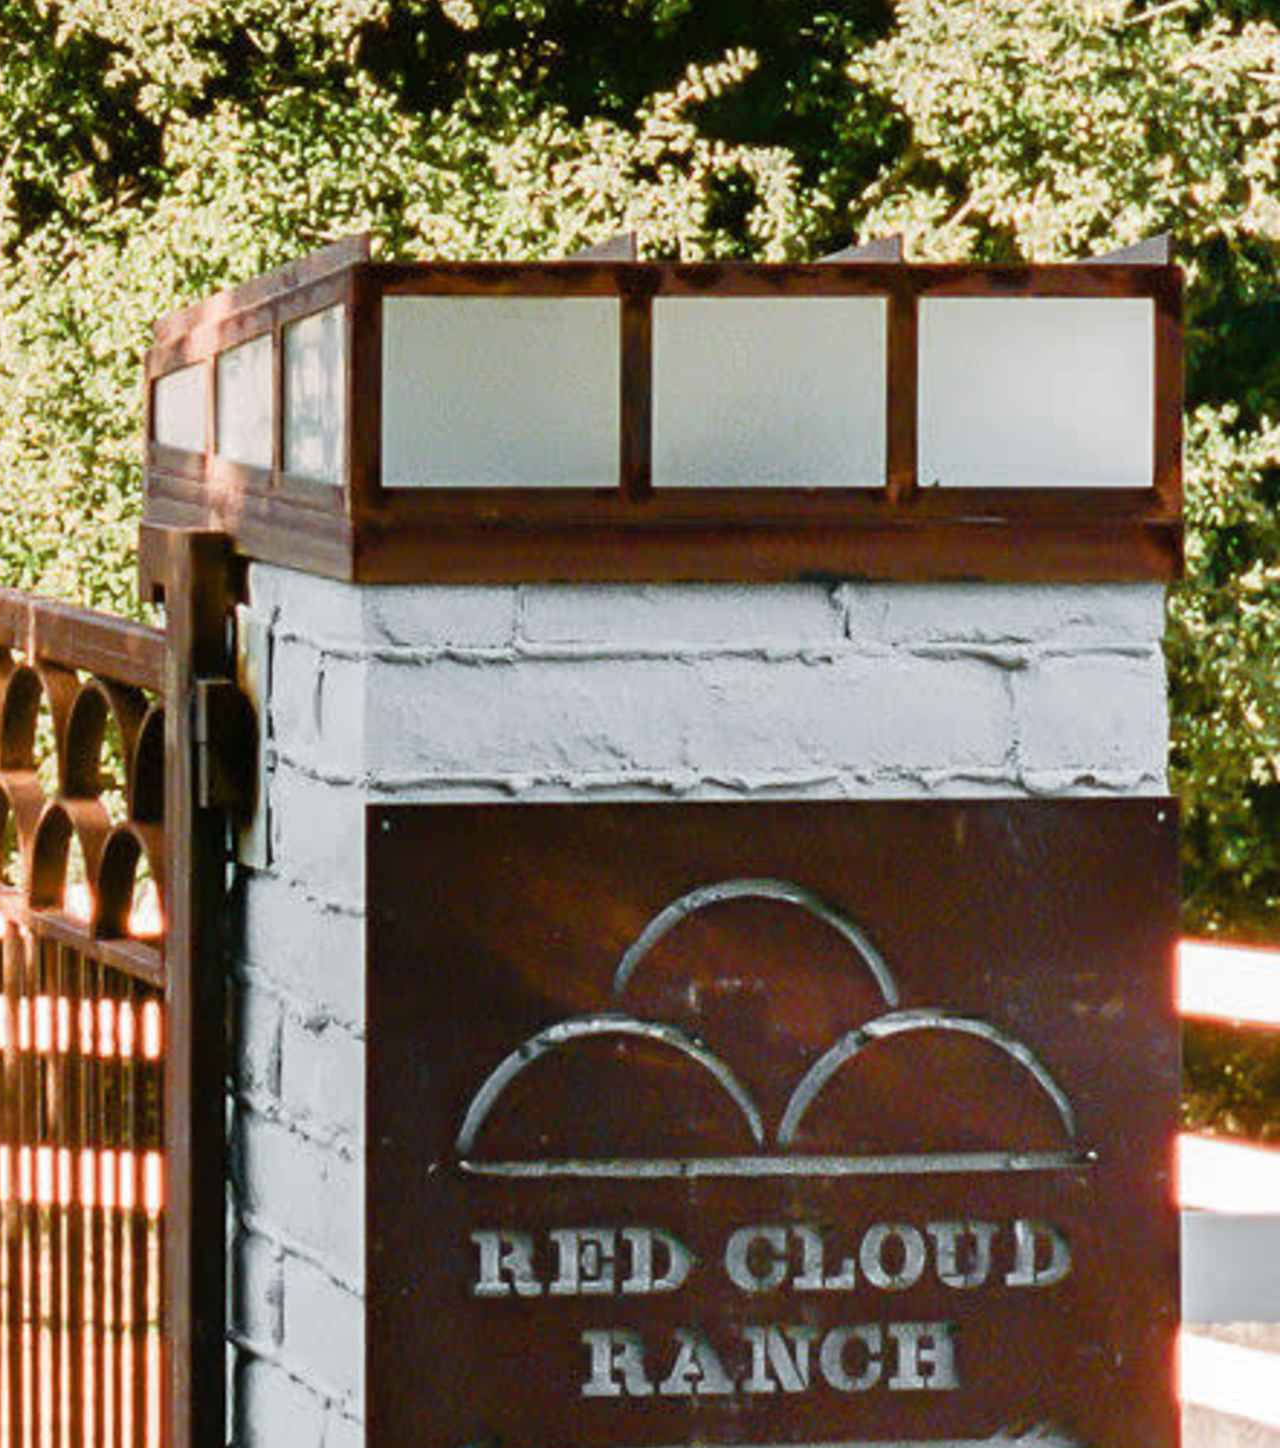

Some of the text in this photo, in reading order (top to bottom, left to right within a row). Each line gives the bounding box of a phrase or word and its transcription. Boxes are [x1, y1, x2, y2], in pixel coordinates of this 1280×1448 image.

[471, 1219, 1074, 1297] RED CLOUD
[581, 1322, 961, 1397] RANCH
